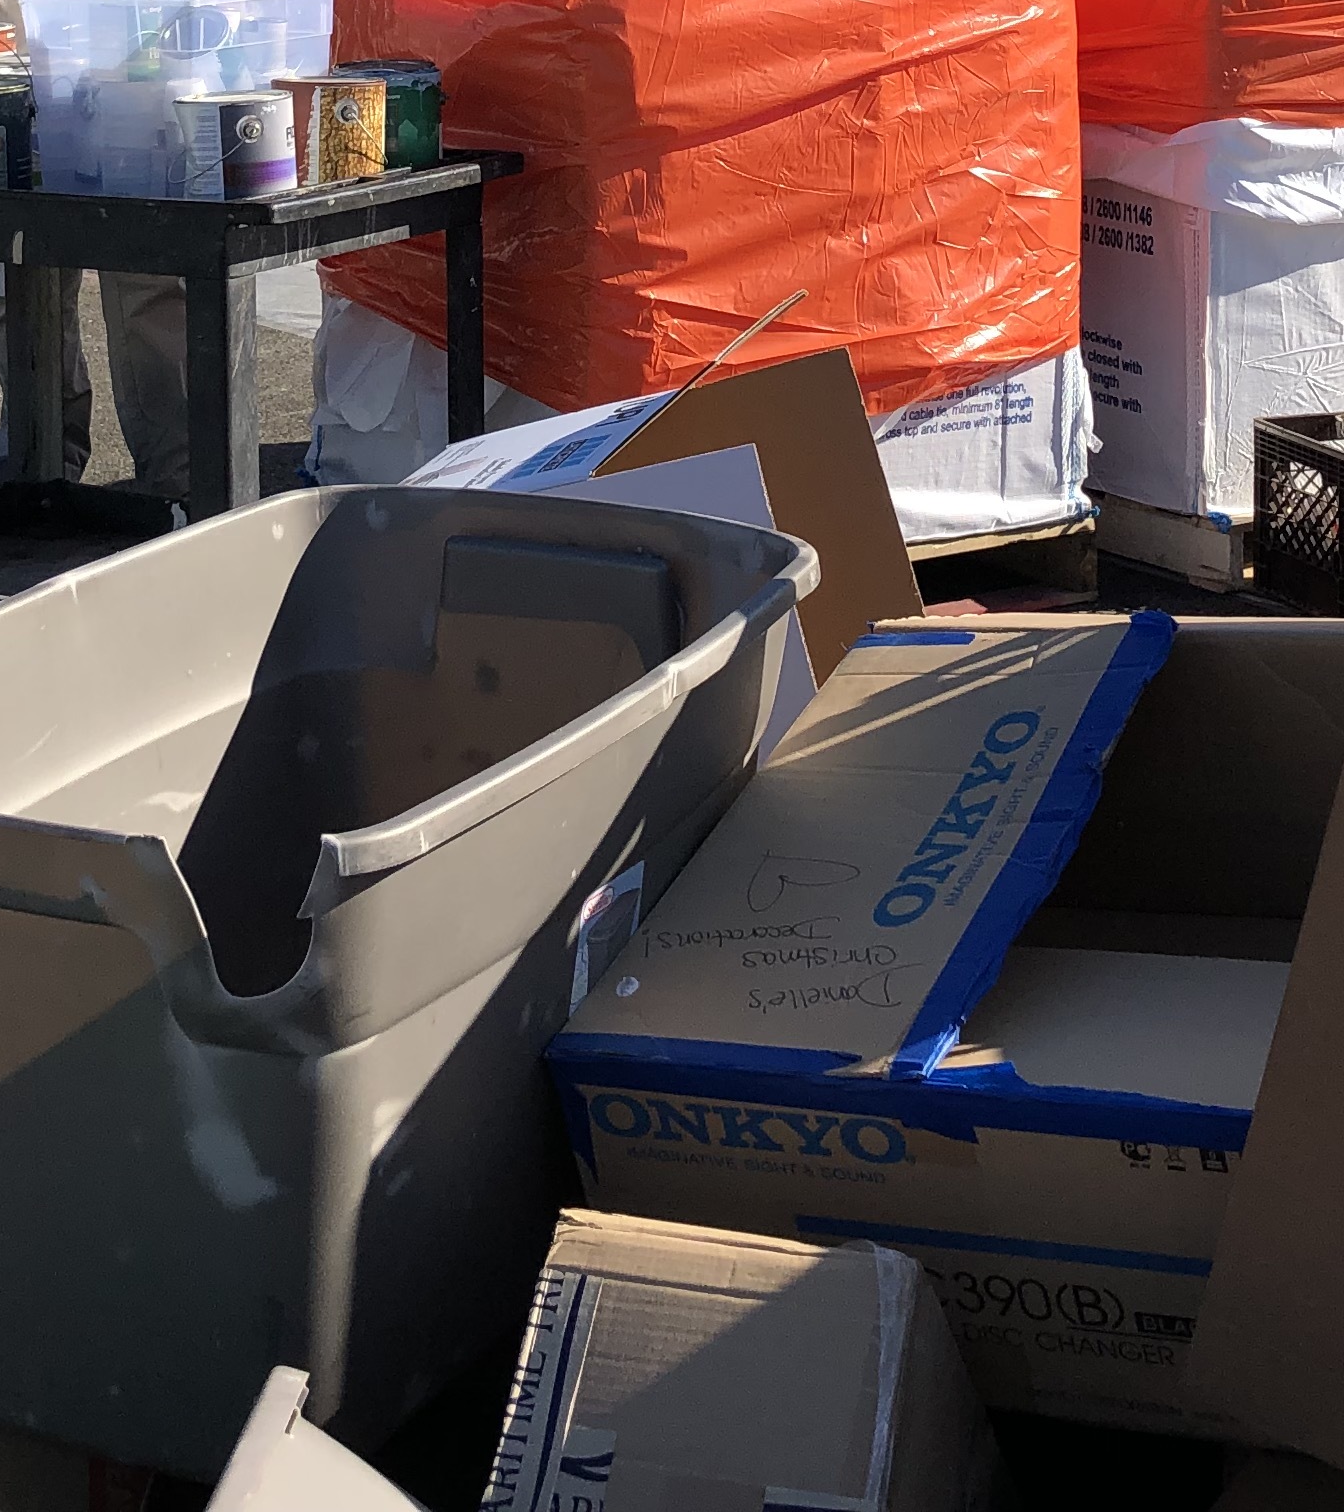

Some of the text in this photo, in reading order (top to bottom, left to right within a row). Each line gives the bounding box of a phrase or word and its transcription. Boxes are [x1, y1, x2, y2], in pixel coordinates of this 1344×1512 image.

[1096, 197, 1121, 222] 2600
[1123, 204, 1153, 227] /1146
[1098, 226, 1123, 250] 2600
[1125, 231, 1154, 256] /1382
[1081, 326, 1123, 351] lockwise
[1087, 349, 1143, 376] closed with
[946, 390, 964, 400] one
[966, 385, 979, 397] full
[981, 382, 1027, 397] revolution,
[1089, 367, 1120, 390] length
[908, 408, 934, 420] cable
[936, 405, 949, 418] tie,
[951, 402, 993, 416] minimum
[1006, 396, 1034, 411] length
[1093, 390, 1142, 414] ecure with
[880, 410, 1032, 439] ross top and secure with attached
[872, 710, 1041, 928] ONKYO
[943, 726, 1059, 906] IMAGINATIVE SIGHT & SOUND
[641, 916, 841, 958] Decorations!
[742, 944, 897, 969] Christmas
[749, 964, 911, 1014] Danielle's
[596, 1092, 907, 1164] ONKYO
[627, 1148, 886, 1185] IMAGINATIVE SIGHT & SOUND
[926, 1267, 1125, 1329] 390(B)
[1142, 1318, 1195, 1338] BLA
[953, 1322, 1175, 1366] -DISC CHANGER
[480, 1351, 547, 1512] ARITIME
